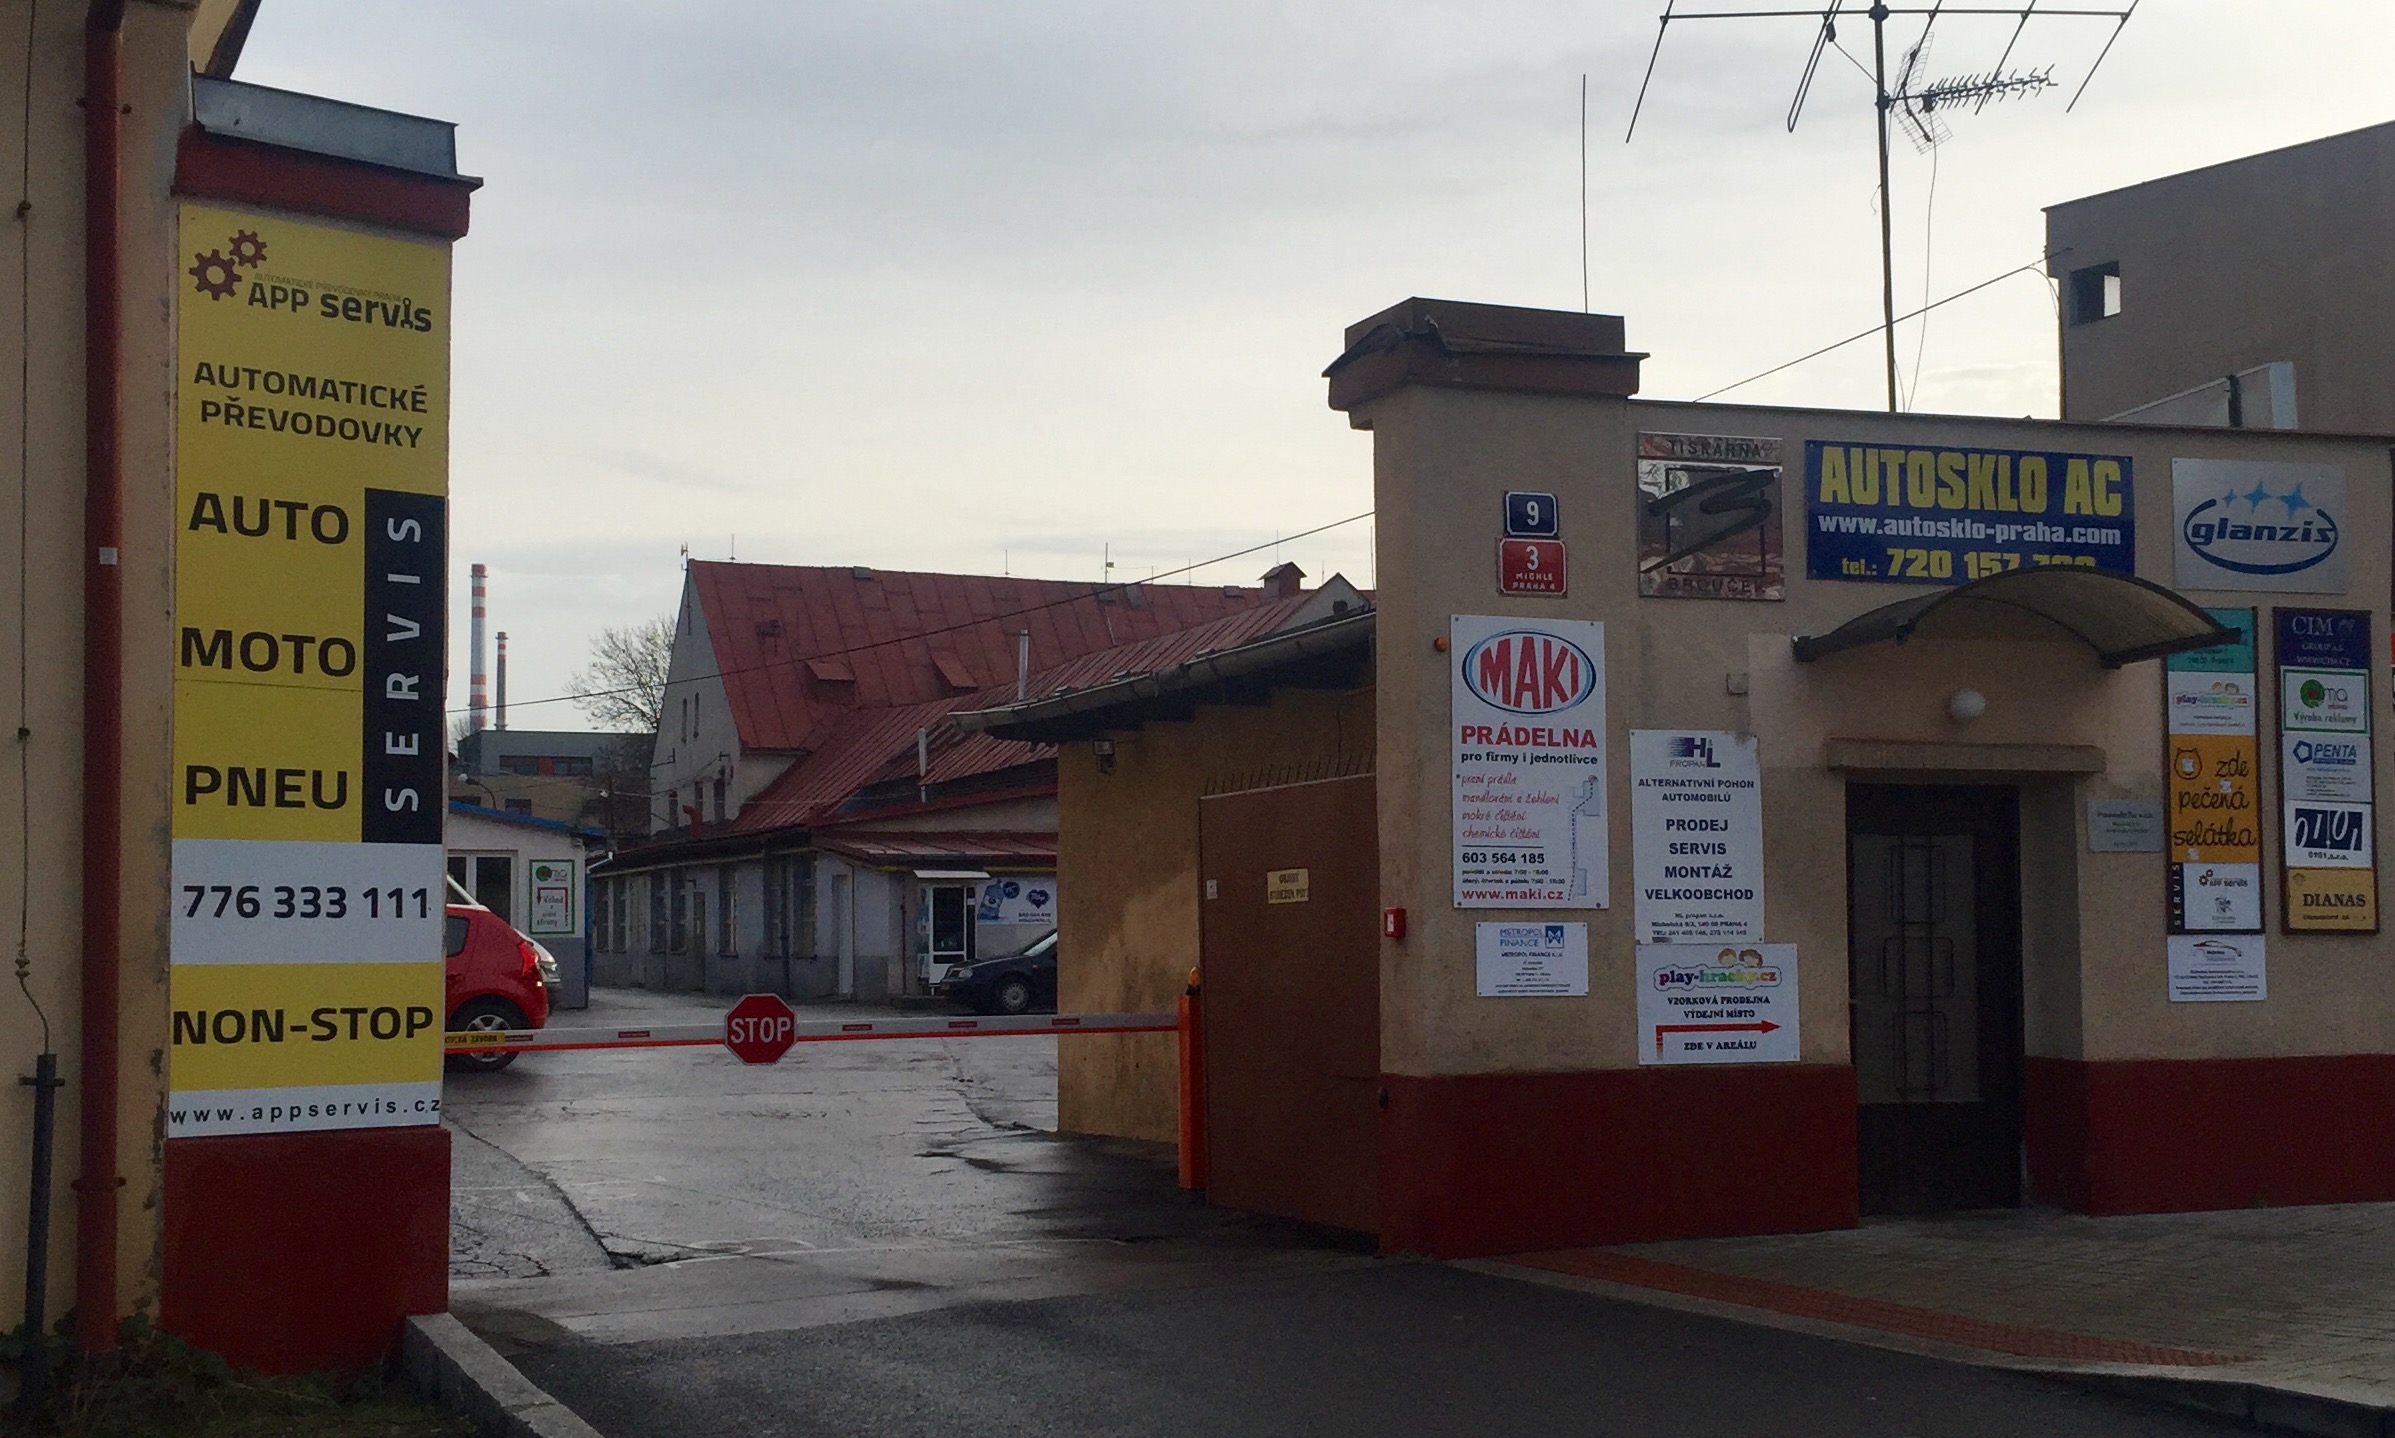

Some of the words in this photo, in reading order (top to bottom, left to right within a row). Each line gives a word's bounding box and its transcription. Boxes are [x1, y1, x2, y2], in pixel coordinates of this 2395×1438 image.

[248, 283, 309, 313] APP
[320, 293, 432, 332] servis
[194, 361, 428, 413] AUTOMATICKÉ
[201, 395, 423, 448] PŘEVODOVKY
[1819, 446, 2047, 514] AUTOSKLO
[2063, 458, 2122, 517] AC
[188, 492, 349, 545] AUTO
[1526, 501, 1539, 526] 9
[1818, 515, 2121, 545] www.autosklo-praha.com
[2190, 517, 2336, 546] glanzis
[1526, 545, 1539, 570] 3
[1841, 556, 1877, 575] tel.:
[1886, 548, 1953, 578] 720
[1513, 582, 1545, 590] PRAHA
[1516, 572, 1553, 581] MICHLE
[2292, 615, 2334, 636] CIM
[182, 627, 355, 676] MOTO
[385, 517, 422, 812] SERVIS
[1480, 636, 1579, 709] MAKI
[1461, 722, 1598, 748] PRÁDELNA
[1461, 752, 1482, 764] pro
[1485, 751, 1519, 765] firmy
[1522, 752, 1527, 763] i
[1529, 752, 1599, 765] jednotlivce
[2214, 748, 2250, 777] zde
[2314, 743, 2357, 758] PENTA
[186, 765, 348, 810] PNEU
[1638, 777, 1715, 788] ALTERNATIVNÍ
[1717, 779, 1754, 789] POHON
[1661, 791, 1731, 802] AUTOMOBILŮ
[2178, 786, 2251, 815] pečená
[1666, 818, 1729, 831] PRODEJ
[2173, 816, 2257, 847] selátka
[1461, 852, 1487, 864] 603
[1491, 852, 1516, 864] 564
[1521, 852, 1545, 864] 185
[1668, 842, 1727, 855] SERVIS
[1664, 863, 1733, 878] MONTÁŽ
[183, 885, 260, 919] 776
[273, 886, 347, 919] 333
[362, 887, 428, 919] 111
[1461, 888, 1564, 900] www.maki.cz
[1645, 888, 1754, 900] VELKOOBCHOD
[2172, 865, 2181, 926] SERVIS
[2302, 893, 2367, 907] DIANAS
[1500, 939, 1539, 947] FINANCE
[1658, 970, 1777, 986] play-hracky.cz
[1667, 995, 1718, 1005] VZORKOVÁ
[1720, 996, 1771, 1005] PRODEJNA
[173, 1006, 434, 1045] NON-STOP
[1683, 1008, 1724, 1019] VÝDEJNÍ
[1726, 1009, 1756, 1019] MÍSTO
[730, 1017, 791, 1044] STOP
[1684, 1041, 1703, 1050] ZDE
[1706, 1041, 1714, 1050] V
[1716, 1040, 1758, 1050] AREÁLU
[170, 1097, 440, 1124] www.appservis.cz
